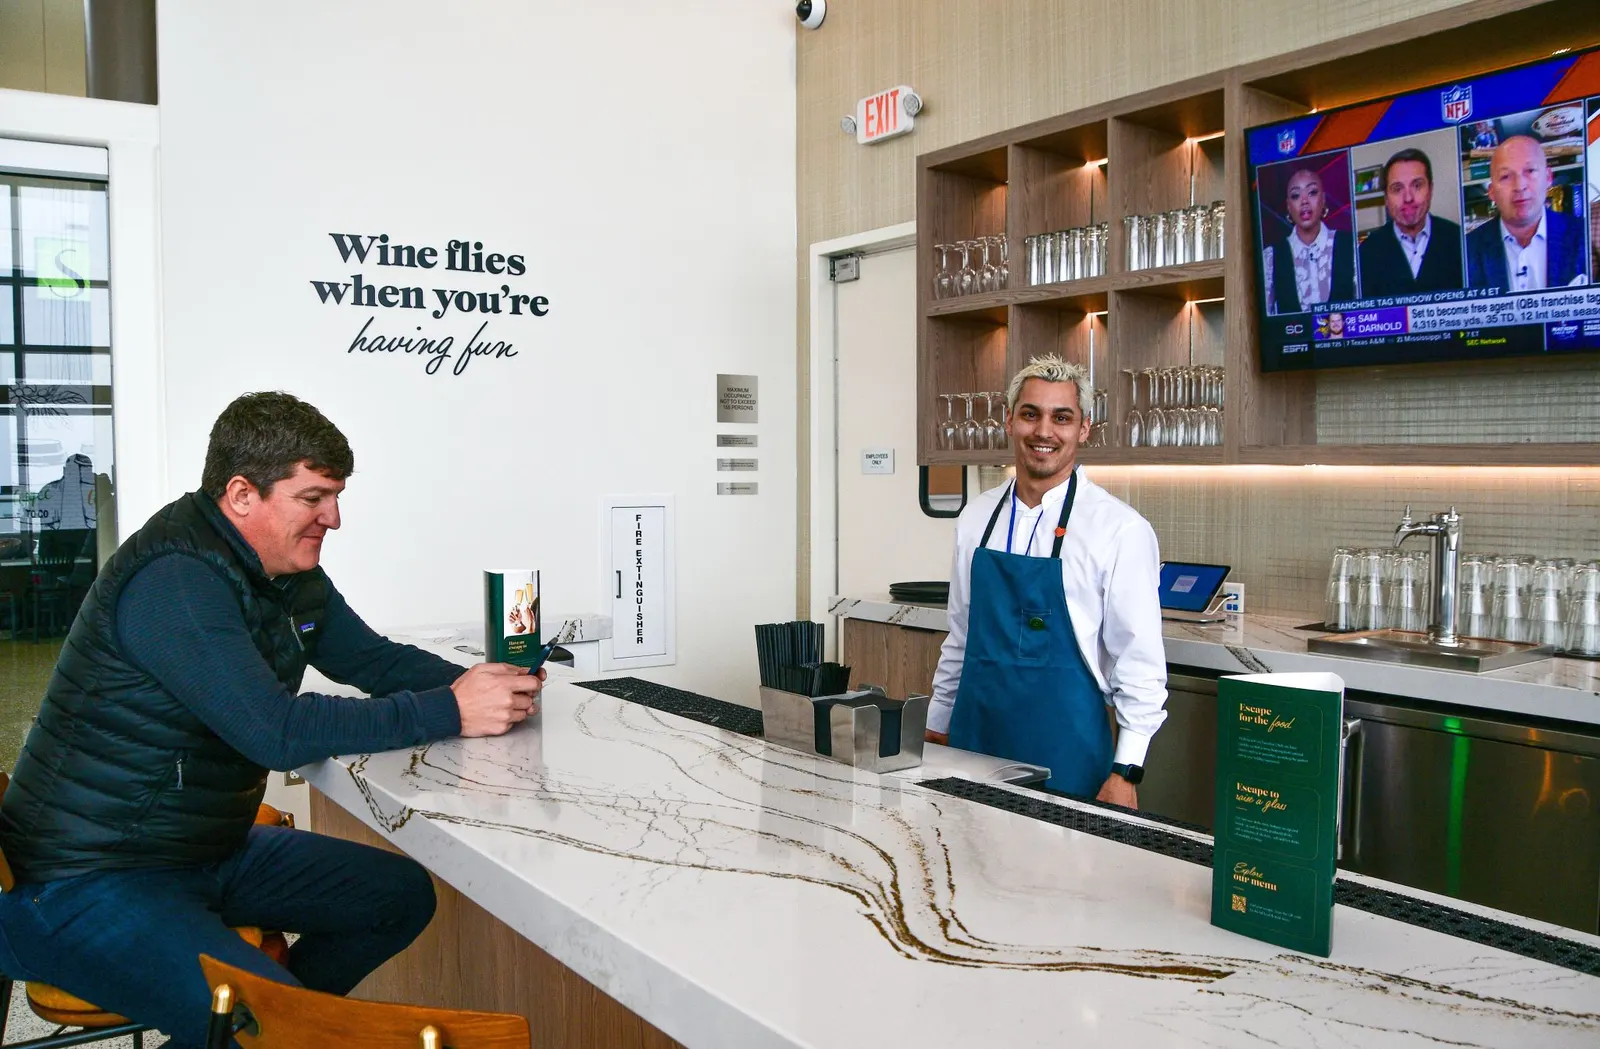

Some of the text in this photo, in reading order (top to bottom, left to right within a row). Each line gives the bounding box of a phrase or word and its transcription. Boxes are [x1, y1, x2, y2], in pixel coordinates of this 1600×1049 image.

[866, 89, 899, 137] EXIT
[1446, 101, 1470, 119] NFL
[329, 233, 526, 276] Wine flies
[310, 274, 549, 319] when you're
[1330, 300, 1375, 311] FRANCHISE
[1378, 298, 1393, 306] TAG
[1396, 294, 1432, 305] WINDOW
[1434, 291, 1465, 301] OPENS
[1467, 290, 1478, 298] AT
[1480, 288, 1486, 296] 4
[1488, 287, 1500, 295] ET
[1412, 308, 1426, 319] Set
[1426, 308, 1434, 317] to
[1436, 303, 1470, 316] become
[1471, 302, 1488, 313] free
[1490, 300, 1514, 314] agent
[1516, 297, 1539, 311] (QBs
[1541, 294, 1585, 307] franchise
[1358, 313, 1377, 323] SAM
[1412, 318, 1437, 330] 4,319
[1439, 316, 1460, 328] Pass
[1486, 313, 1498, 324] 35
[1521, 311, 1533, 321] 12
[1535, 309, 1548, 319] Int
[1551, 308, 1570, 319] last
[1285, 325, 1303, 335] SC
[1358, 321, 1402, 333] DARNOLD
[348, 316, 519, 376] having fun
[1404, 334, 1441, 342] Mississippi
[1480, 337, 1507, 345] Network
[1283, 343, 1308, 353] ESPN
[1239, 702, 1272, 716] Escape
[1239, 712, 1296, 733] for the food
[1236, 782, 1280, 798] Escape to
[1261, 798, 1288, 813] glass
[1233, 861, 1263, 878] Explore
[1233, 873, 1277, 891] our menu
